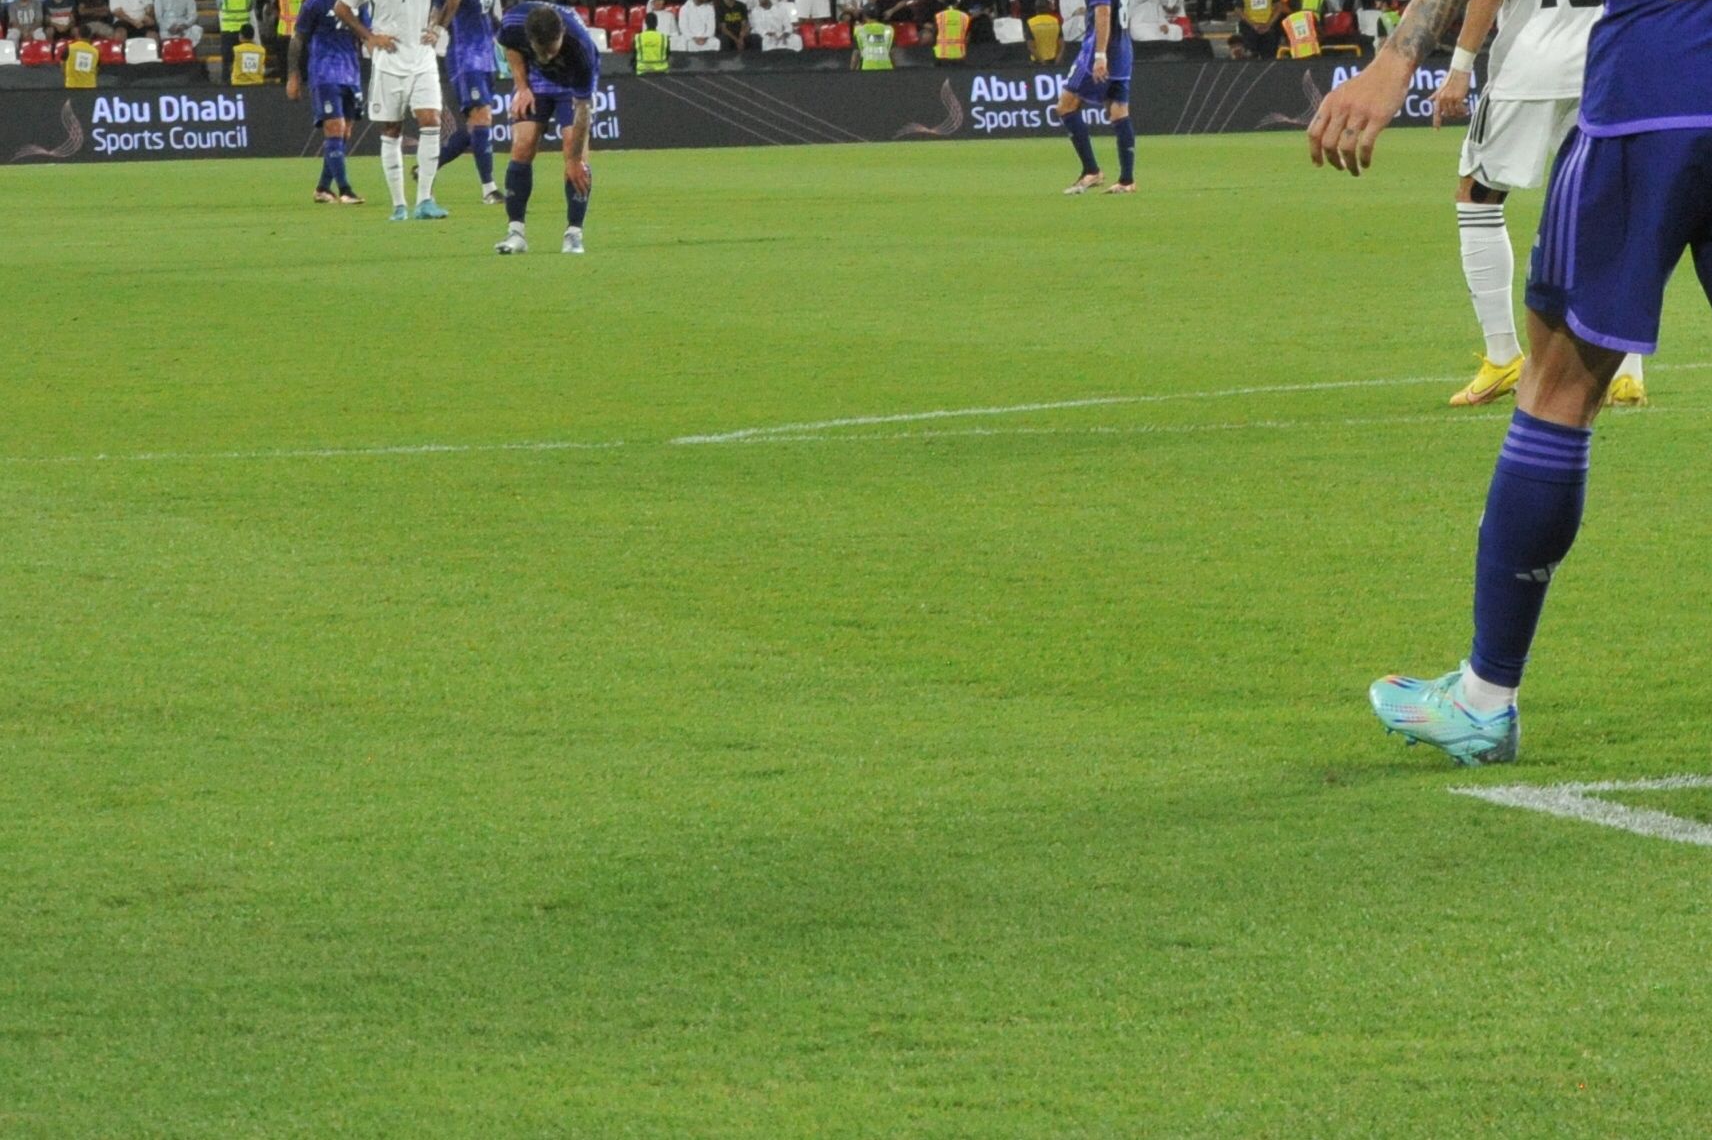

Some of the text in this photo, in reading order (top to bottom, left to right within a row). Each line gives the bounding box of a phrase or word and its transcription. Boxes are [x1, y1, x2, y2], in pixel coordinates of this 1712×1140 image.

[971, 75, 1027, 102] Abu
[92, 93, 246, 123] Abu Dhabi
[971, 106, 1041, 133] Sports
[92, 125, 248, 155] Sports Council
